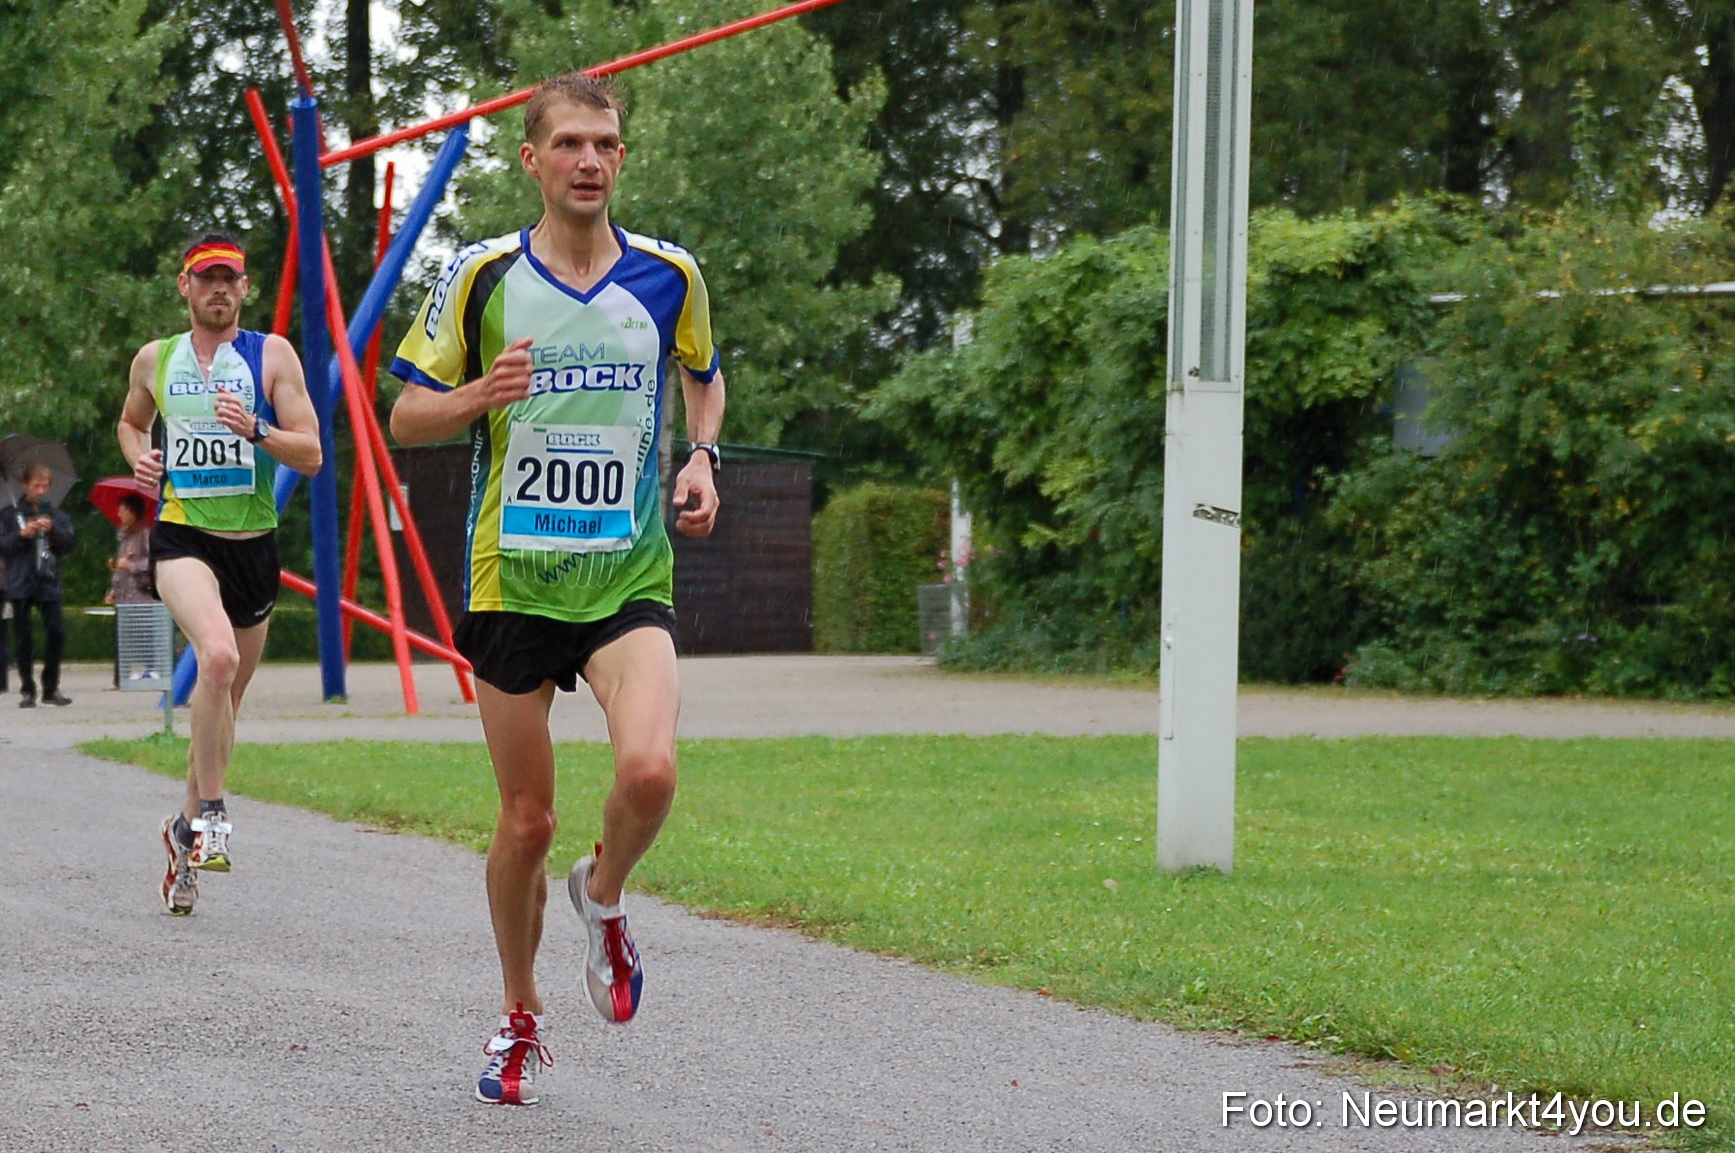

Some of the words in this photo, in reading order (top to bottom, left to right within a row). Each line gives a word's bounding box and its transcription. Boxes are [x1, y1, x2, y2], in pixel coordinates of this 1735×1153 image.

[526, 342, 605, 365] TEAM
[530, 363, 646, 396] BOCK
[545, 432, 601, 446] BOCK
[175, 438, 242, 467] 2001
[192, 473, 228, 486] Marco
[516, 456, 624, 505] 2000
[534, 513, 602, 535] Michael
